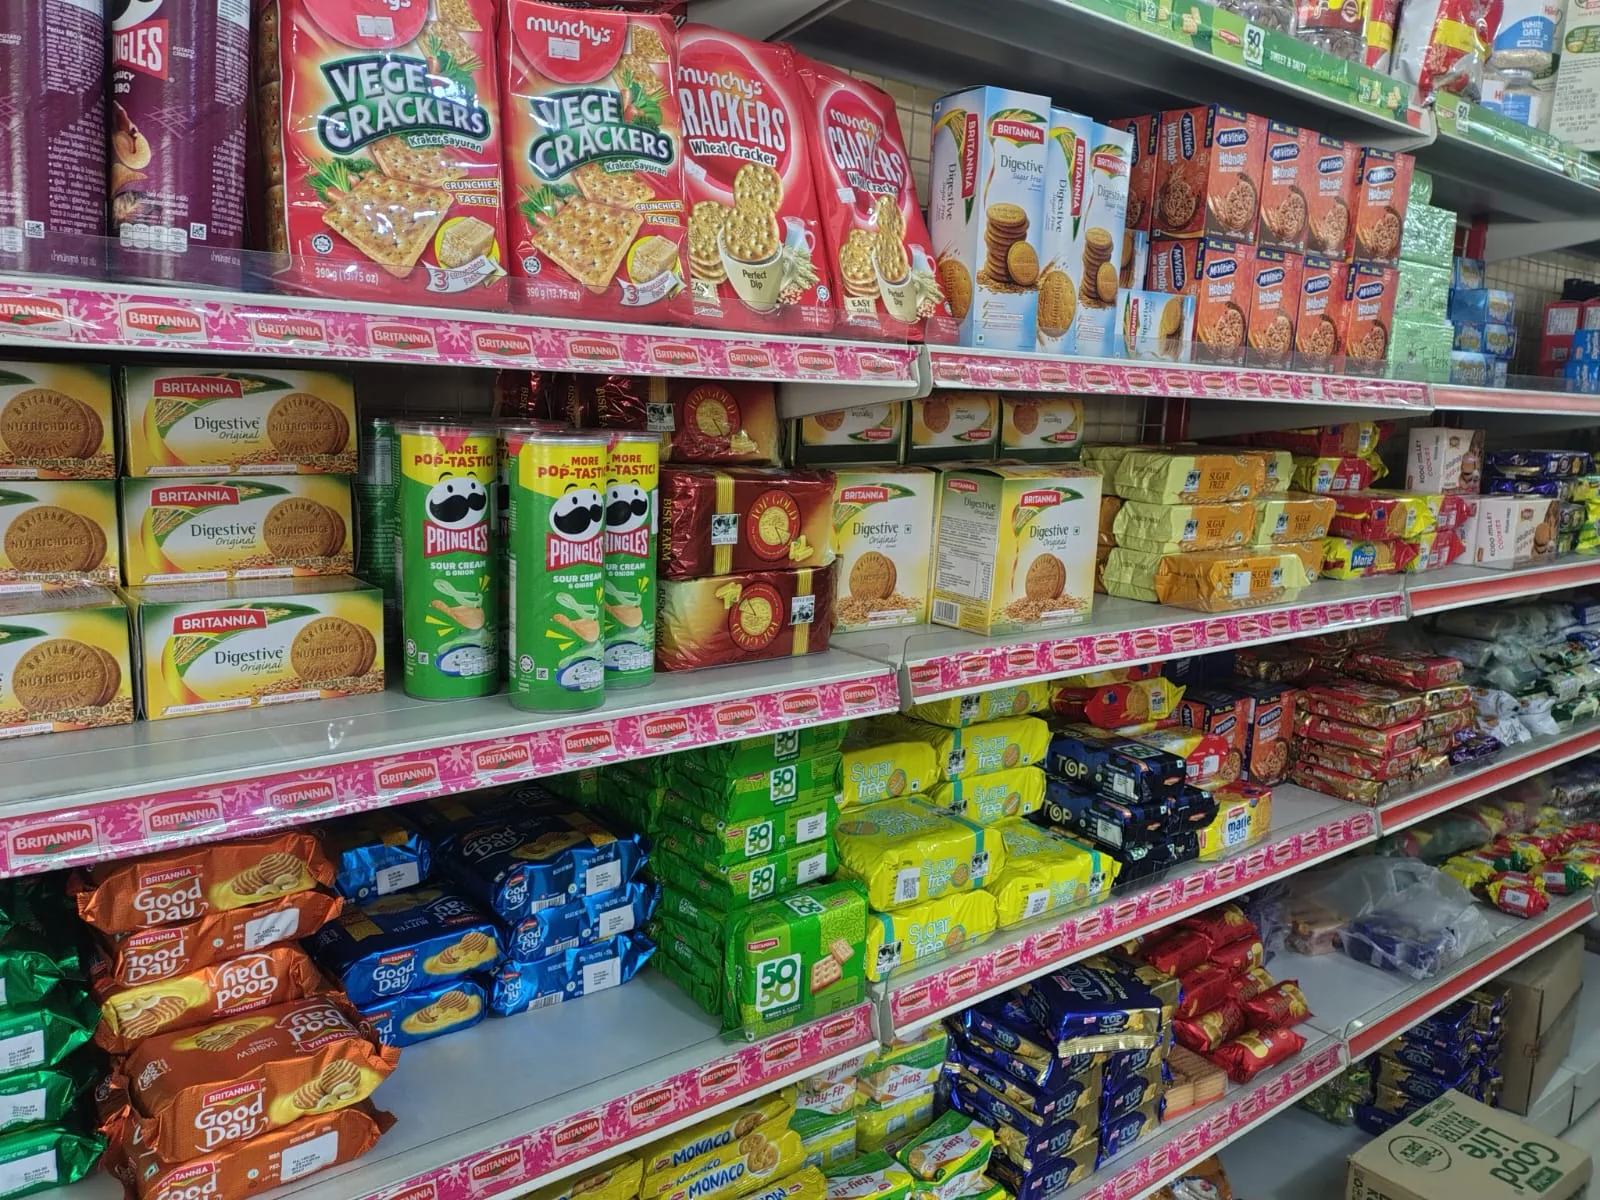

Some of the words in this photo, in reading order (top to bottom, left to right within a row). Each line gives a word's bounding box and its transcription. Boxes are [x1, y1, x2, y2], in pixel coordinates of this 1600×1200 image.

[526, 17, 612, 46] munchy's
[1247, 20, 1261, 47] 50
[332, 63, 426, 103] VEGE
[678, 66, 763, 97] munchy's
[544, 94, 620, 124] VEGE
[326, 95, 483, 148] CRACKERS
[997, 123, 1040, 140] BRITANNIA
[535, 126, 669, 170] CRACKERS
[692, 140, 731, 157] Wheat
[732, 143, 776, 166] Cracker
[827, 125, 902, 184] CRACKERS
[964, 121, 976, 190] BRITANNIA
[1000, 154, 1043, 175] Digestive
[444, 179, 499, 190] CRUNCHIER
[1073, 144, 1085, 209] BRITANNIA
[457, 196, 498, 205] TASTIER
[946, 163, 957, 221] Digestive
[1055, 179, 1066, 233] Digestive
[433, 274, 447, 290] 3
[742, 269, 767, 280] Perfect
[750, 279, 763, 290] Dip
[851, 298, 870, 308] EASY
[129, 313, 199, 329] BRITANNIA
[373, 331, 430, 345] BRITANNIA
[478, 337, 529, 352] BRITANNIA
[729, 352, 769, 366] BRITANNIA
[799, 355, 832, 367] BRITANNIA
[162, 382, 234, 394] BRITANNIA
[194, 417, 260, 432] Digestive
[219, 431, 259, 441] Original
[414, 452, 494, 467] POP-TASTIC!
[571, 456, 599, 466] MORE
[612, 454, 641, 463] MORE
[1209, 472, 1230, 481] SUGAR
[1209, 481, 1225, 490] FREE
[159, 490, 230, 502] BRITANNIA
[844, 490, 884, 501] BRITANNIA
[1023, 495, 1057, 504] BRITANNIA
[664, 498, 672, 519] BISK
[752, 496, 769, 521] TOP
[772, 492, 798, 520] GOLD
[191, 524, 256, 539] Digestive
[427, 524, 488, 554] PRINGLES
[853, 522, 899, 539] Digestive
[1030, 526, 1069, 541] Digestive
[216, 536, 256, 548] Original
[662, 521, 672, 560] FARM
[430, 561, 456, 570] SOUR
[457, 560, 486, 569] CREAM
[620, 562, 646, 571] CREAM
[1352, 555, 1374, 567] Marie
[553, 575, 576, 583] SOUR
[1253, 578, 1269, 587] FREE
[182, 614, 258, 629] BRITANNIA
[733, 622, 759, 645] GOLD
[762, 620, 778, 644] TOP
[215, 648, 283, 665] Digestive
[240, 660, 283, 674] Original
[784, 697, 817, 710] BRITANNIA
[843, 688, 876, 703] BRITANNIA
[647, 722, 686, 736] BRITANNIA
[776, 738, 796, 754] 50
[972, 736, 1007, 756] Sugar
[479, 750, 527, 768] BRITANNIA
[978, 751, 1001, 768] free
[1057, 756, 1088, 778] TOP
[381, 767, 434, 786] BRITANNIA
[773, 768, 794, 786] 50
[851, 763, 891, 782] Sugar
[773, 782, 794, 798] 50
[858, 779, 885, 797] free
[152, 806, 218, 826] BRITANNIA
[1044, 801, 1072, 824] TOP
[1228, 816, 1251, 830] marie
[16, 827, 91, 849] BRITANNIA
[748, 825, 770, 842] 50
[1229, 830, 1247, 844] GOLD
[748, 839, 770, 855] 50
[146, 869, 192, 885] BRITANNIA
[751, 868, 772, 883] 50
[134, 879, 202, 911] Good
[752, 882, 773, 897] 50
[146, 903, 196, 925] Day
[909, 918, 950, 941] Sugar
[118, 932, 178, 947] BRITANNIA
[916, 940, 944, 957] free
[128, 960, 176, 982] Day
[222, 960, 267, 988] Day
[372, 960, 415, 980] Good
[762, 959, 798, 984] 50
[216, 977, 278, 1008] Good
[379, 975, 411, 992] Day
[760, 981, 796, 1009] 50
[1102, 1015, 1122, 1024] TOP
[996, 1030, 1014, 1044] TOP
[765, 1040, 799, 1060] BRITANNIA
[888, 1072, 921, 1093] Stay-Fit
[209, 1083, 256, 1103] BRITANNIA
[632, 1089, 672, 1113] BRITANNIA
[805, 1085, 845, 1105] Stay-Fit
[1057, 1091, 1077, 1112] TOP
[194, 1095, 263, 1130] Good
[205, 1118, 256, 1147] Day
[1051, 1128, 1071, 1150] TOP
[674, 1131, 730, 1166] MONACO
[935, 1136, 964, 1161] Stay-Fit
[1459, 1128, 1520, 1159] Life
[474, 1152, 520, 1176] BRITANNIA
[1490, 1142, 1560, 1189] Good
[689, 1163, 744, 1198] MONACO
[832, 1175, 873, 1196] Stay-Fit
[1044, 1168, 1069, 1188] TOP
